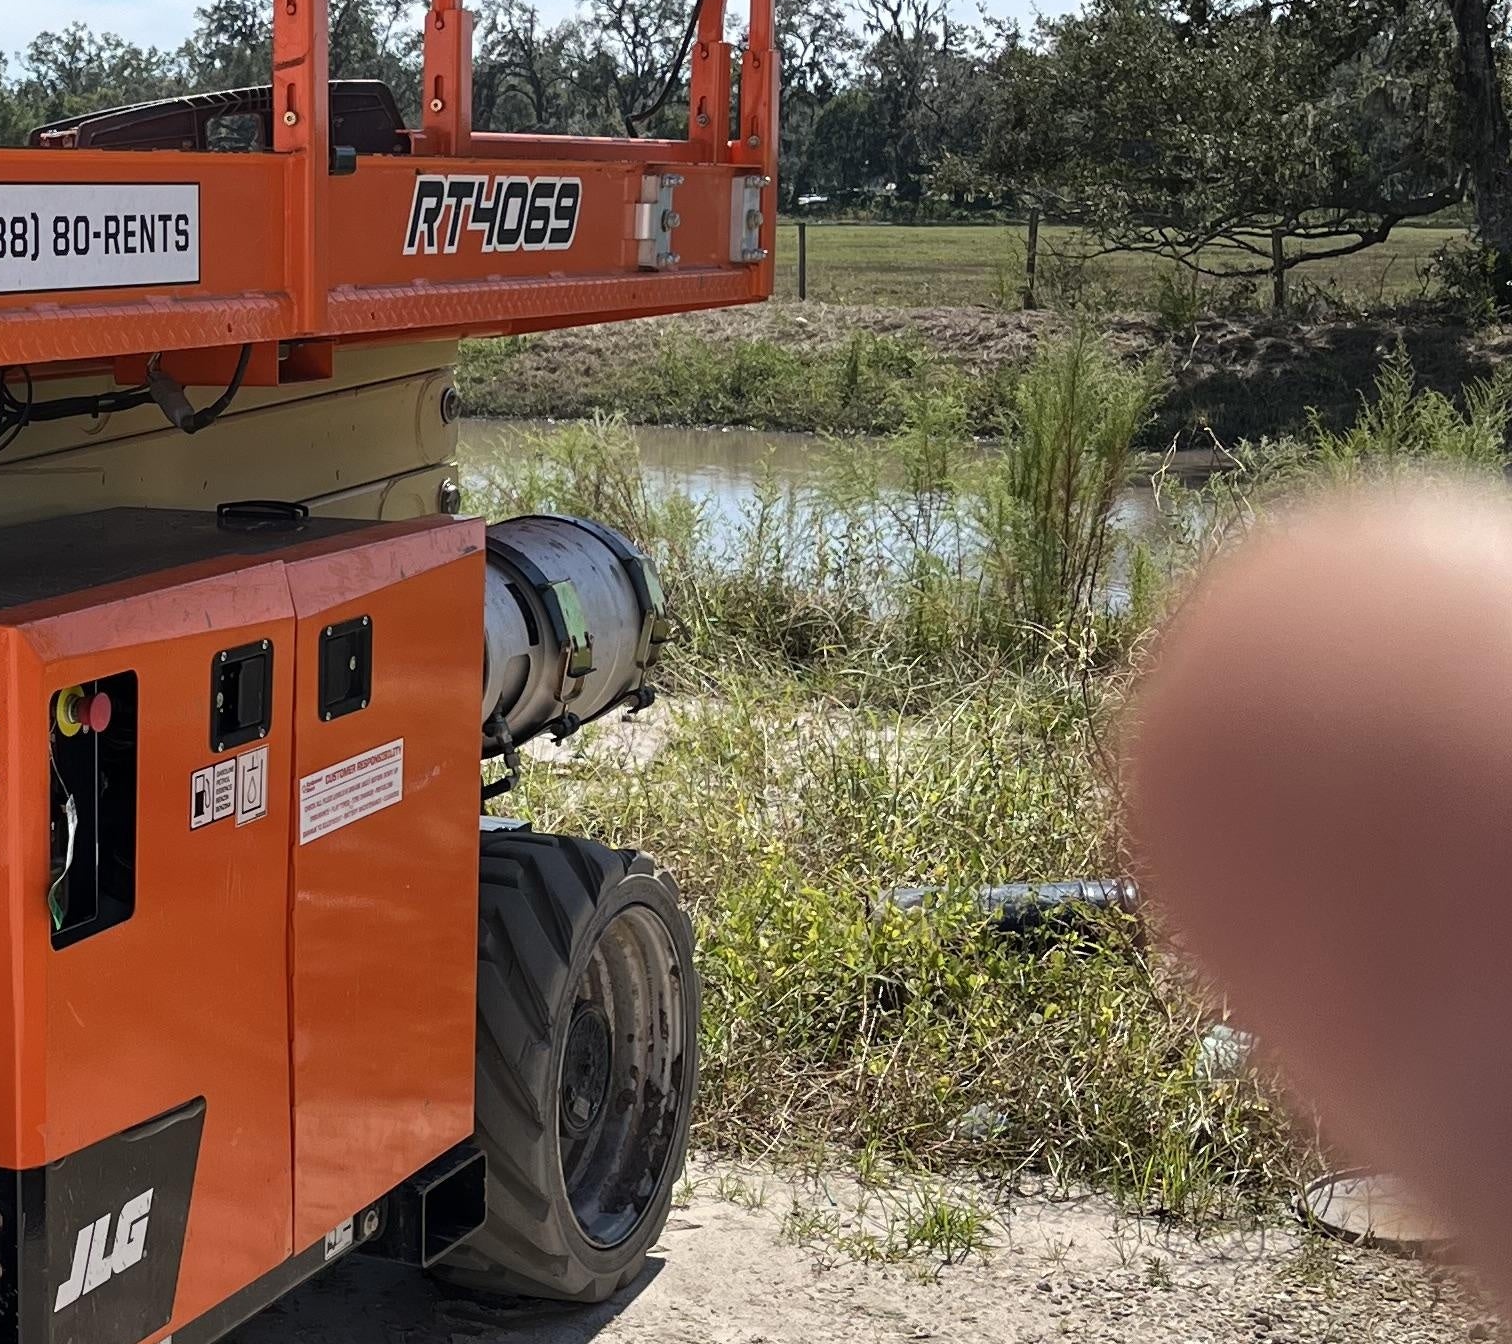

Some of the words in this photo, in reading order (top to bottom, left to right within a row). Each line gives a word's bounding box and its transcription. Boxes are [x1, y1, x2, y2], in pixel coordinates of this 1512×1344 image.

[53, 213, 190, 257] 80-RENTS
[402, 174, 583, 256] RT4069
[325, 763, 356, 785] CUSTOMER
[356, 745, 402, 771] RESPONSIBILITY
[54, 1187, 154, 1313] JLG
